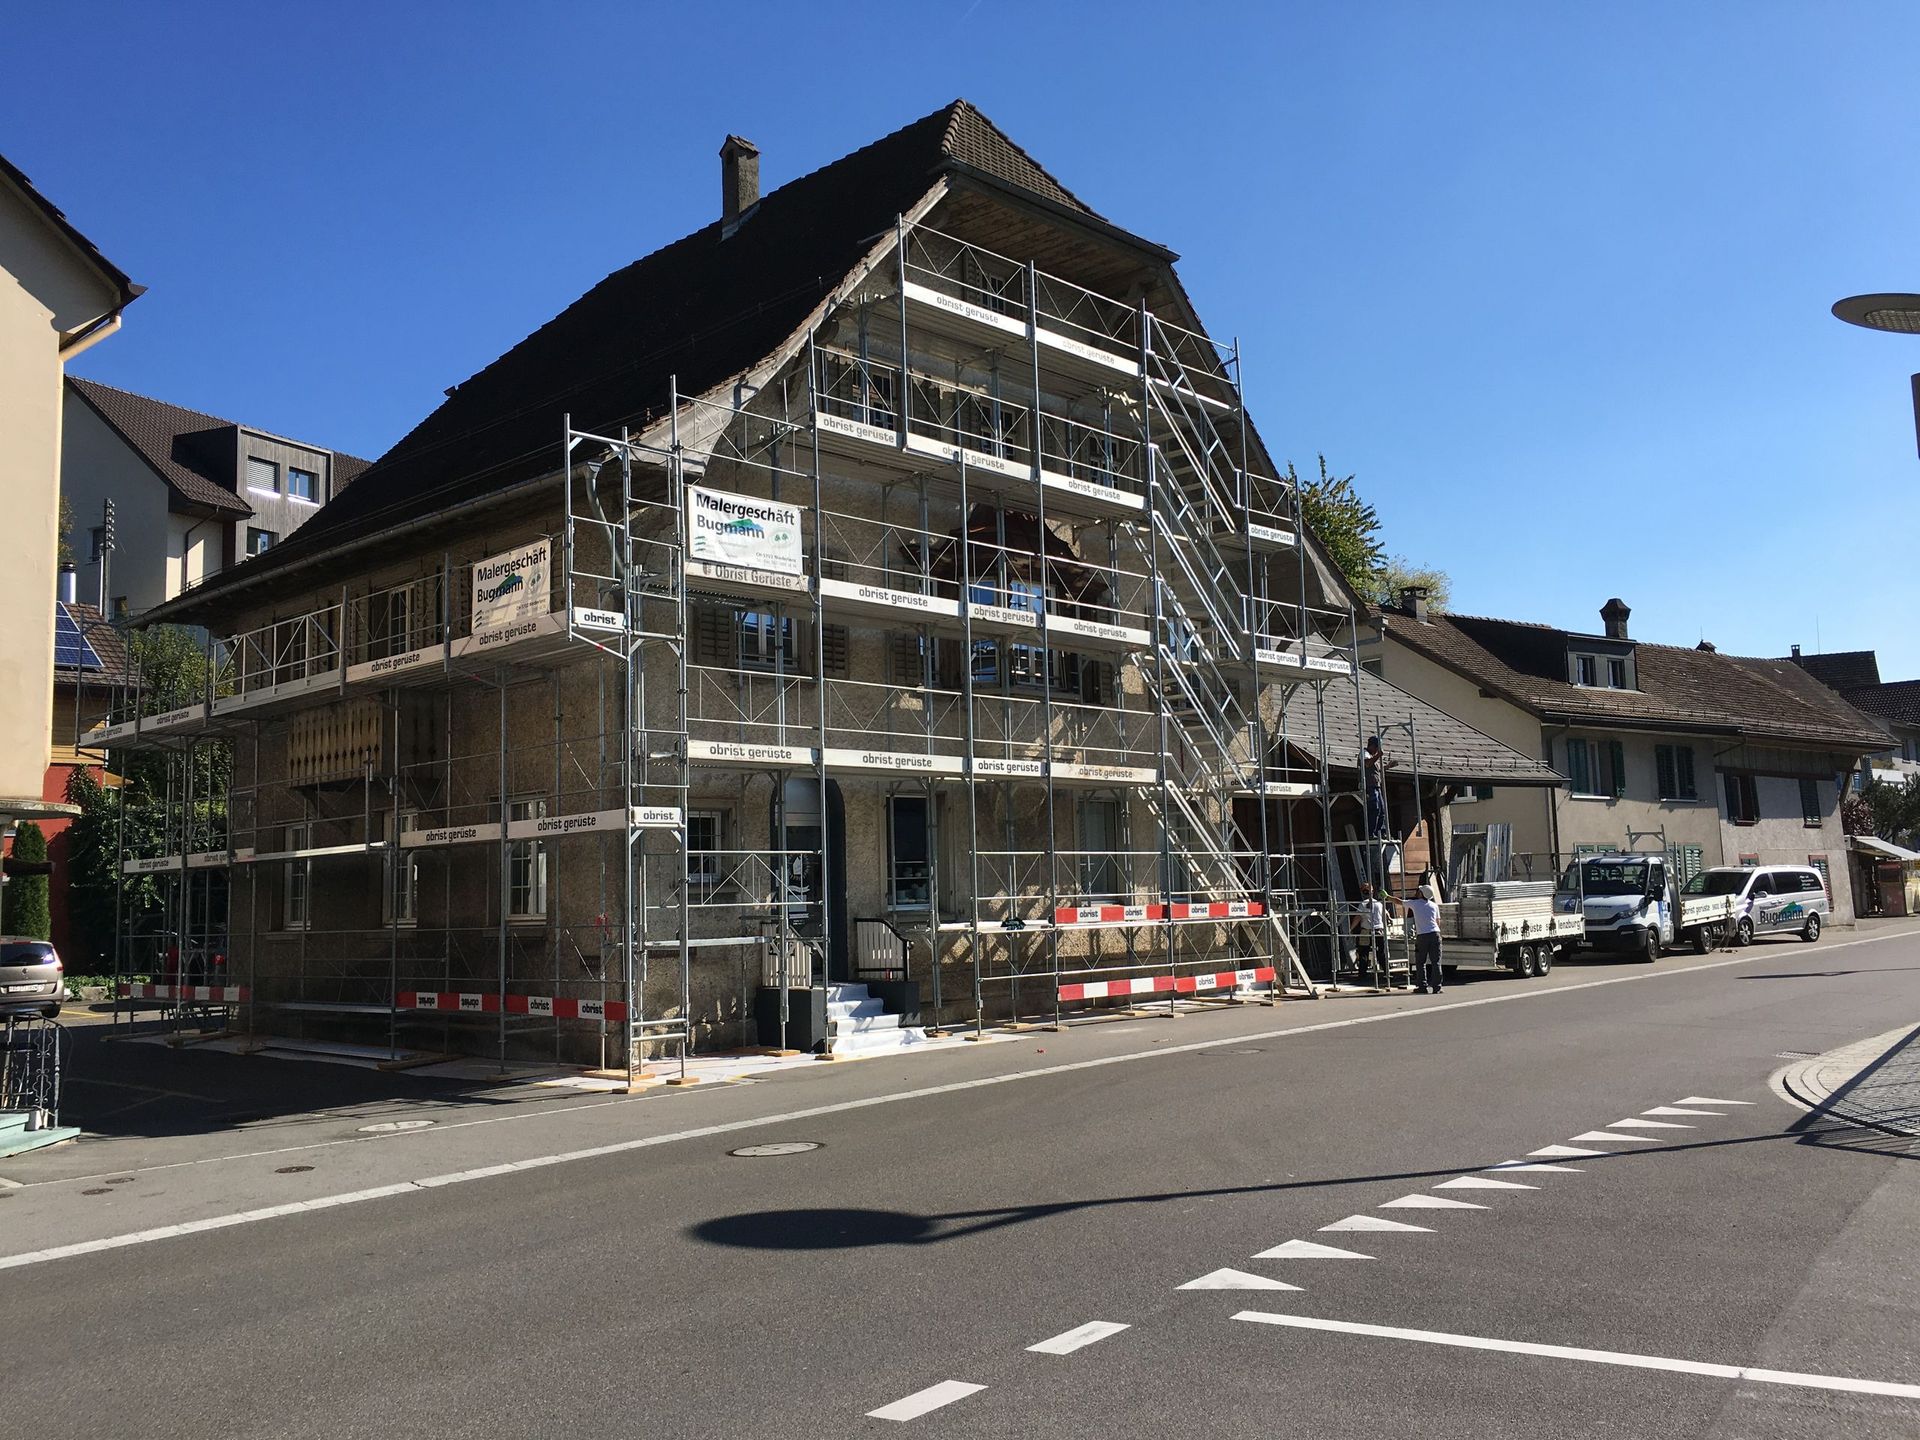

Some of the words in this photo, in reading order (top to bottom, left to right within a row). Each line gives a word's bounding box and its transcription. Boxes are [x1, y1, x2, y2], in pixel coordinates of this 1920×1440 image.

[937, 296, 964, 311] obrist
[824, 416, 854, 432] obrist
[1069, 480, 1091, 493] obrist
[696, 493, 795, 525] Malergeschäft
[697, 514, 765, 540] Bugmann
[477, 547, 547, 582] Malergeschäft
[715, 563, 748, 582] Obrist
[477, 579, 523, 603] Bugmann
[859, 587, 889, 600] obrist
[891, 594, 928, 608] gerüste
[584, 612, 616, 625] obrist
[974, 606, 1000, 618] obrist
[1074, 621, 1097, 633] obrist
[480, 628, 504, 646] obrist
[371, 658, 392, 673] obrist
[710, 743, 745, 756] obrist
[748, 747, 792, 760] gerüste
[863, 752, 893, 765] obrist
[895, 757, 932, 768] gerüste
[978, 760, 1004, 771] obrist
[1007, 762, 1039, 774] gerüste
[1080, 766, 1102, 776] obrist
[643, 810, 674, 821] obrist
[537, 817, 562, 832] obrist
[563, 815, 596, 832] gerüste
[426, 829, 447, 842] obrist
[1080, 909, 1099, 918] obrist
[1125, 908, 1143, 917] obrist
[530, 999, 550, 1011] obrist
[582, 1003, 603, 1015] obrist
